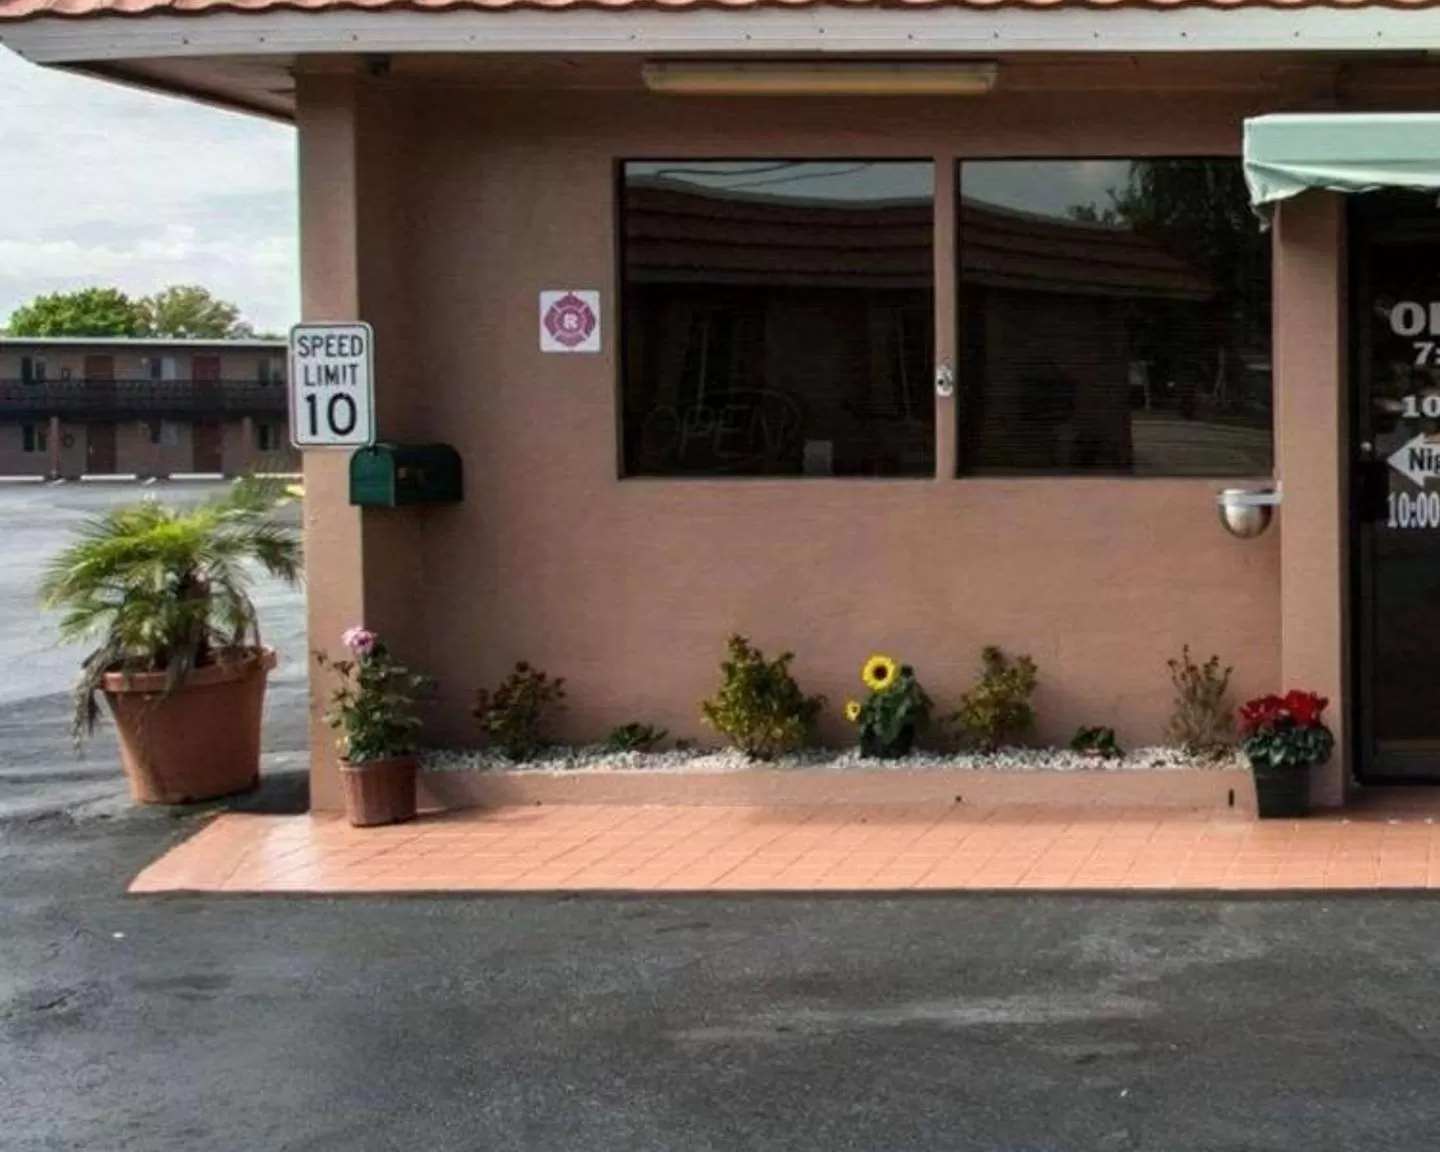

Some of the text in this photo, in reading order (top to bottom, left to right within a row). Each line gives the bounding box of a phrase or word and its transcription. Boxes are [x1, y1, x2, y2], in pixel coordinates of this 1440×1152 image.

[297, 334, 364, 358] SPEED
[303, 363, 359, 387] LIMIT
[304, 392, 357, 437] 10
[1387, 491, 1440, 528] 10:00
